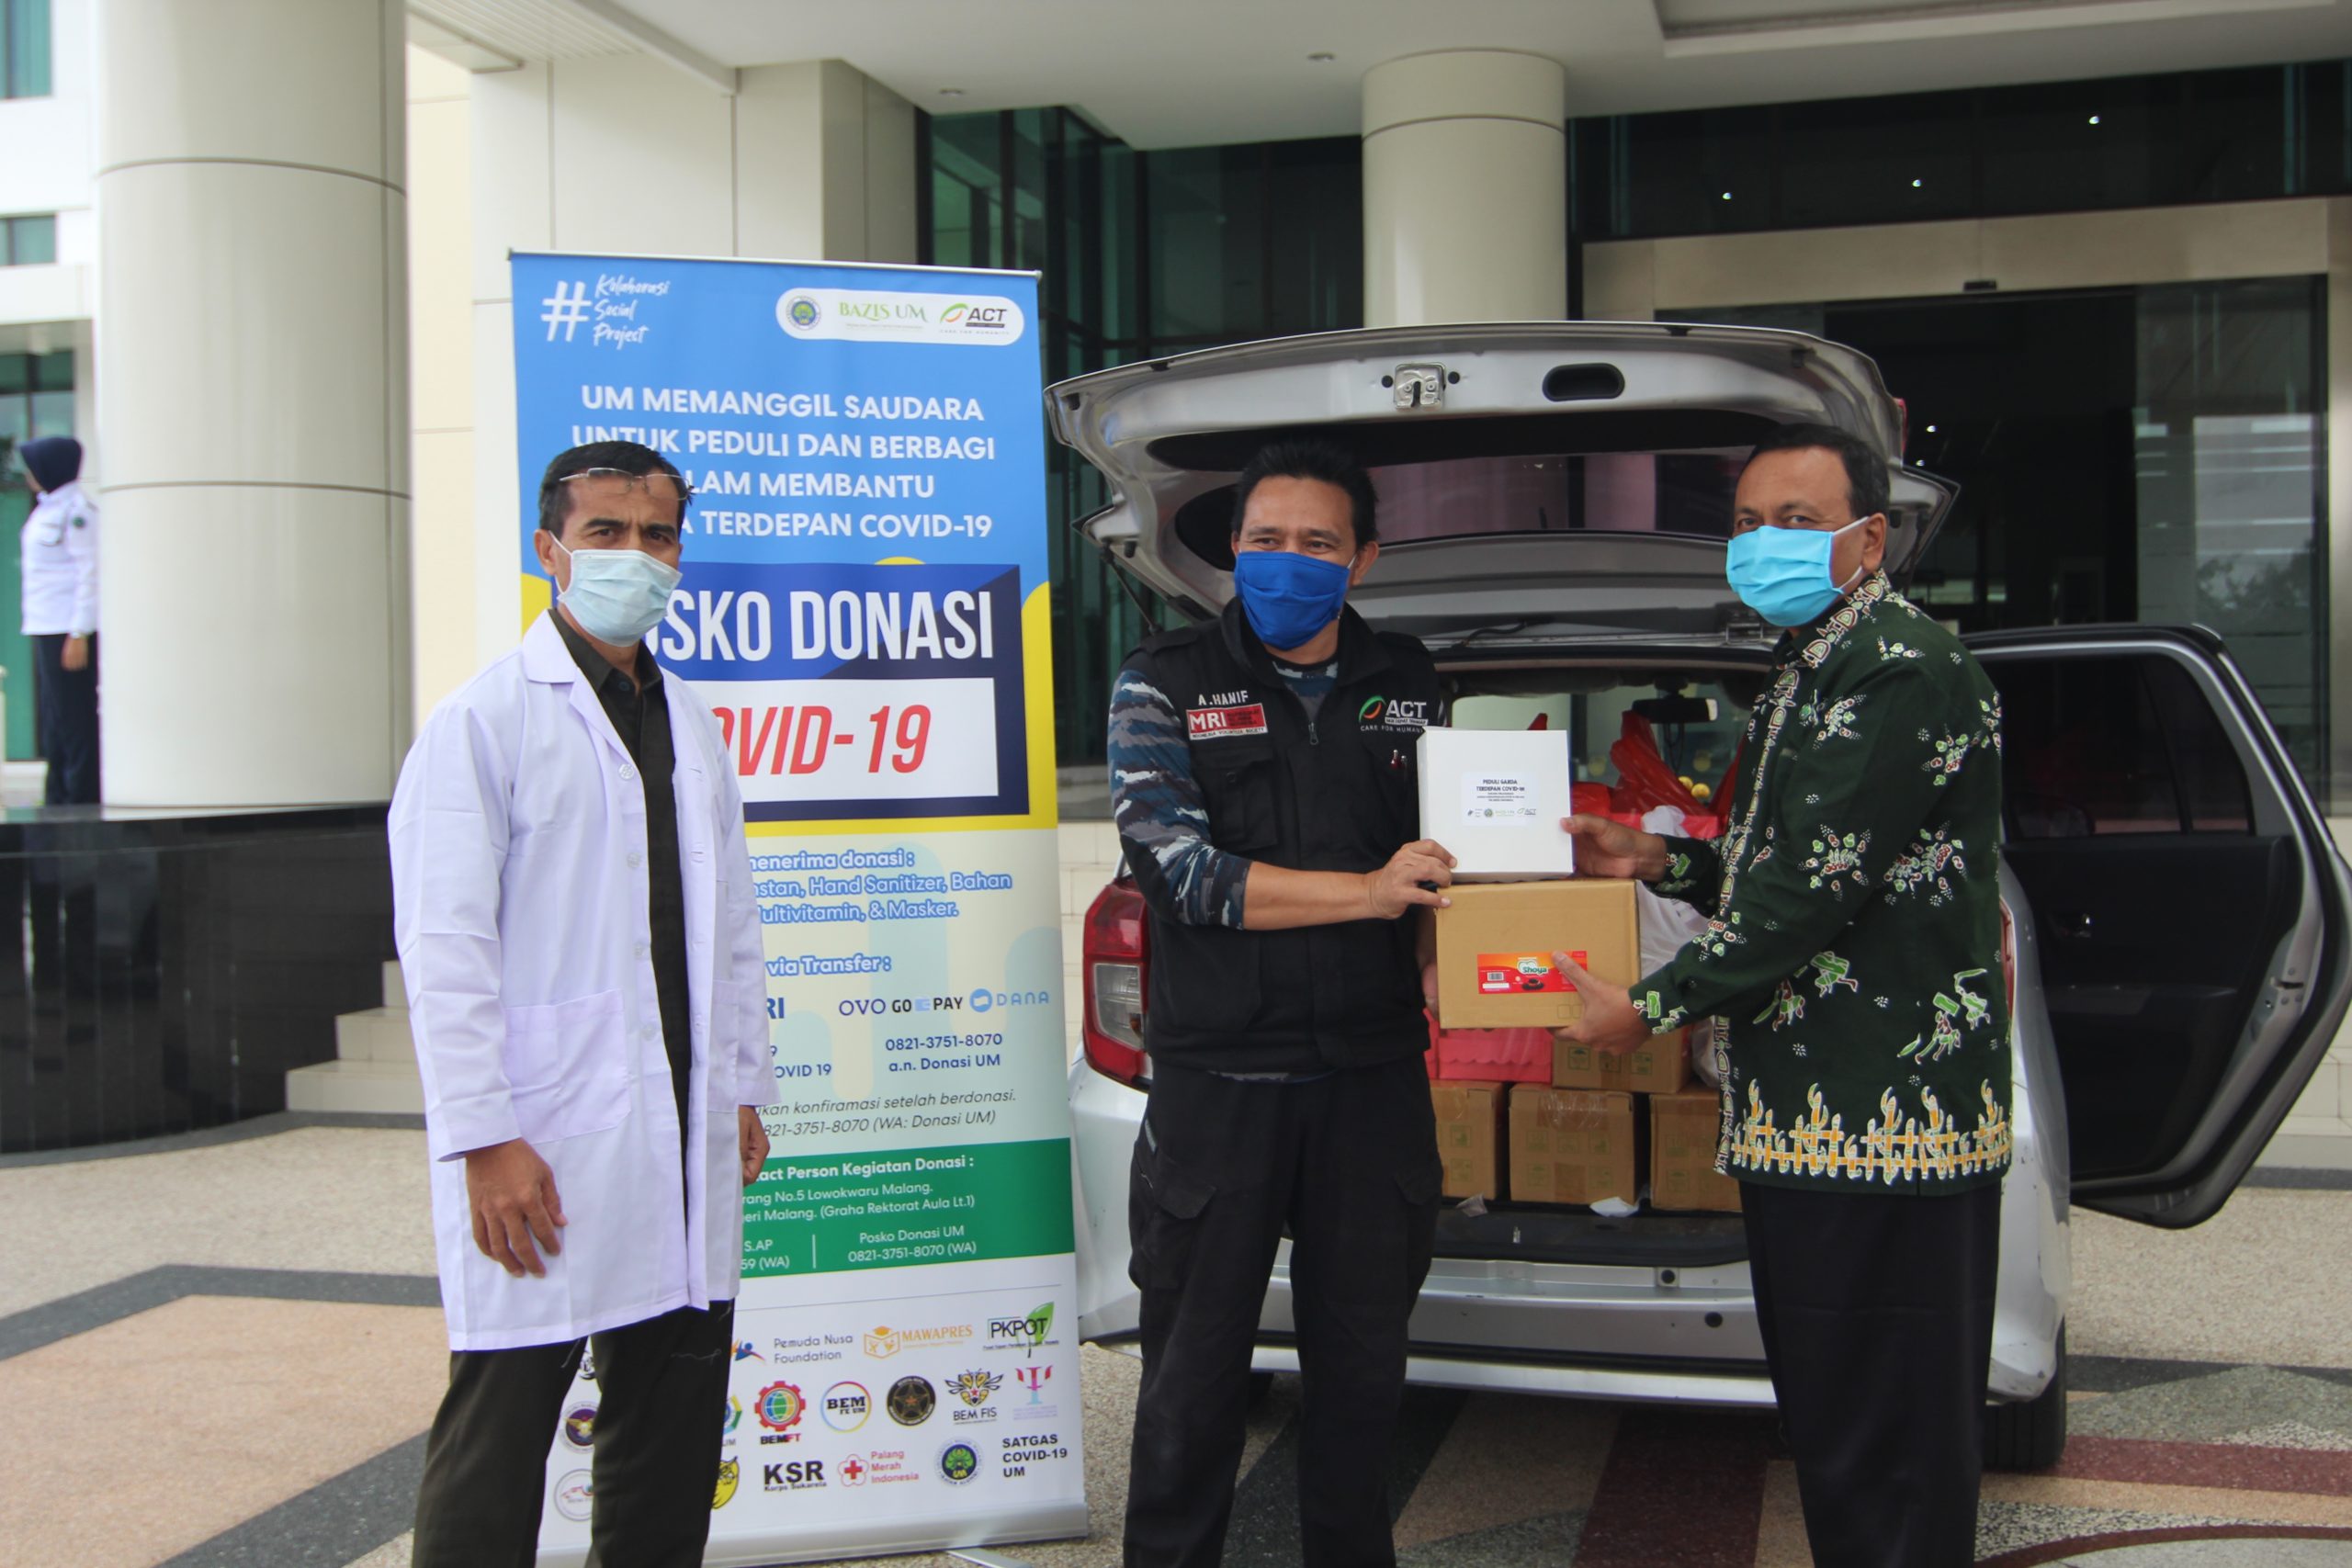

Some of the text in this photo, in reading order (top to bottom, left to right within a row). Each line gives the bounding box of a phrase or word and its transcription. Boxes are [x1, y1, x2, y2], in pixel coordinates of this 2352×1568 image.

[594, 299, 638, 321] Social
[839, 301, 890, 321] BAZIS
[895, 302, 929, 323] UM
[967, 308, 1008, 322] ACT
[593, 321, 650, 350] Project
[582, 385, 985, 421] UM MEMANGGIL SAUDARA
[572, 425, 995, 459] UNTUK PEDULI DAN BERBAGI
[684, 469, 934, 498] LAM MEMBANTU
[700, 511, 853, 536] TERDEPAN
[859, 513, 993, 538] COVID-19
[645, 590, 993, 661] SKO DONASI
[1385, 699, 1427, 718] ACT
[1189, 711, 1227, 731] MRI
[711, 705, 932, 776] VID-19
[753, 871, 1012, 898] nstan, Hand Sanitizer, Bahan
[757, 898, 959, 924] ultivitamin, & Masker.
[766, 956, 799, 976] via
[1522, 965, 1547, 974] Shoya
[839, 998, 887, 1016] OVO
[996, 991, 1050, 1007] DANA
[885, 1032, 1003, 1052] 0821-3751-8070
[774, 1063, 831, 1078] OVID 19
[888, 1054, 1001, 1072] a.n. Donasi UM
[884, 1093, 936, 1109] setelah
[940, 1089, 1016, 1105] berdonasi.
[764, 1110, 996, 1137] 821-3751-8070 (WA: Donasi UM)
[786, 1166, 839, 1179] Person
[842, 1160, 911, 1178] Kegiatan
[915, 1155, 966, 1171] Donasi
[741, 1182, 933, 1206] rang No.5 Lowokwaru Malang.
[742, 1195, 976, 1224] eri Malang. (Graha Rektorat Aula Lt.1)
[859, 1225, 965, 1244] Posko Donasi UM
[847, 1241, 977, 1262] 0821-3751-8070 (WA)
[759, 1255, 790, 1270] (WA)
[901, 1325, 973, 1341] MAWAPRES
[990, 1317, 1048, 1338] PKPOT
[774, 1335, 854, 1348] Pemuda Nusa
[774, 1350, 842, 1364] Foundation
[827, 1396, 865, 1409] BEM
[953, 1407, 997, 1421] BEM FIS
[1002, 1434, 1058, 1449] SATGAS
[871, 1450, 905, 1460] Palang
[1002, 1448, 1068, 1463] COVID-19
[763, 1461, 824, 1484] KSR
[871, 1461, 901, 1471] Merah
[1003, 1466, 1025, 1478] UM
[871, 1472, 920, 1483] Indonesia
